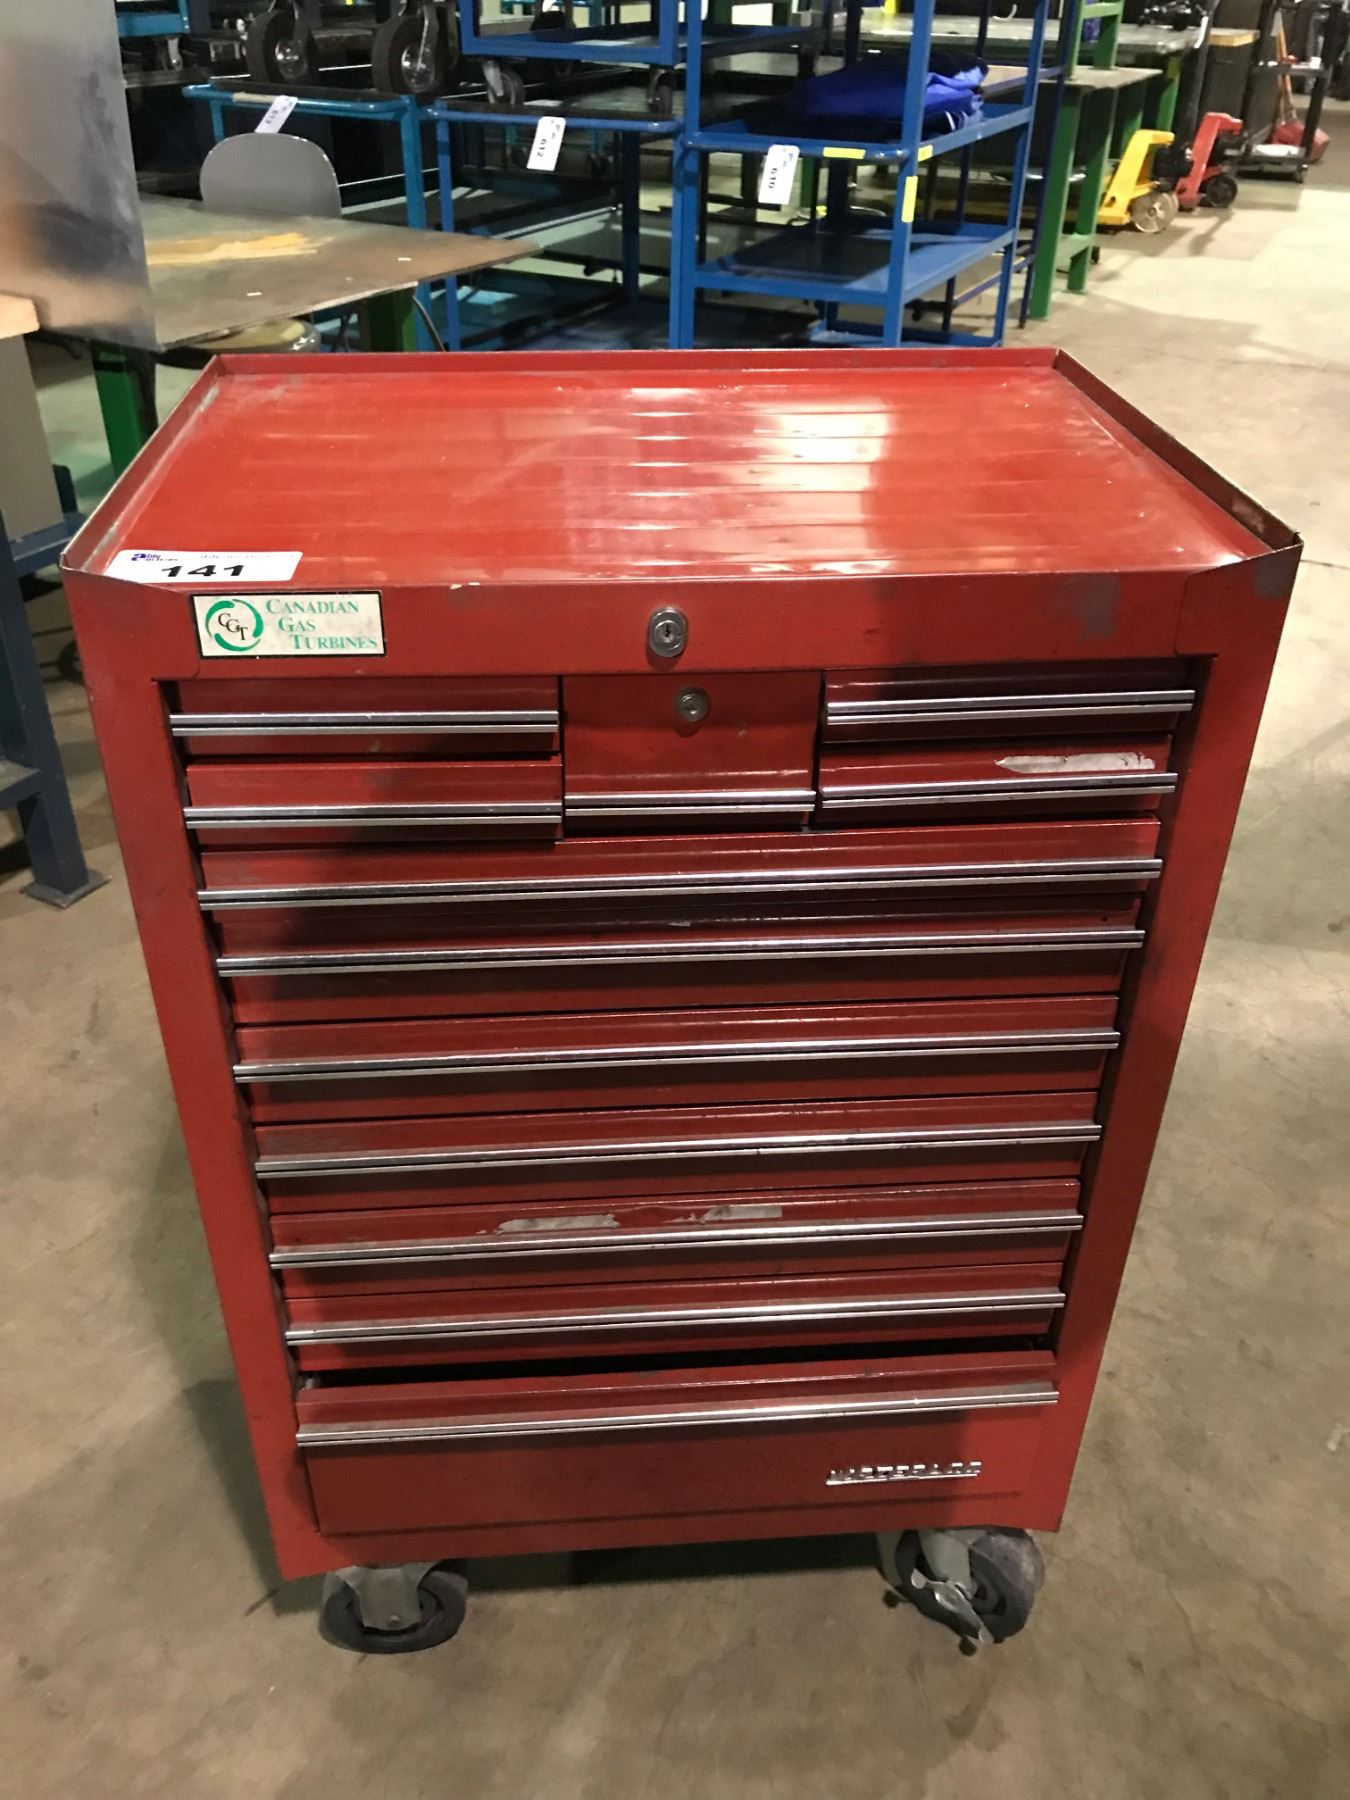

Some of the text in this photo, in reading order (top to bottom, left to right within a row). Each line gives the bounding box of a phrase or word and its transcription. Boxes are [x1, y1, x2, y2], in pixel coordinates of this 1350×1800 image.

[161, 564, 244, 578] 141
[265, 598, 360, 615] CANADIAN
[217, 612, 249, 641] CGT
[278, 616, 317, 633] GAS
[289, 634, 378, 651] TURBINES
